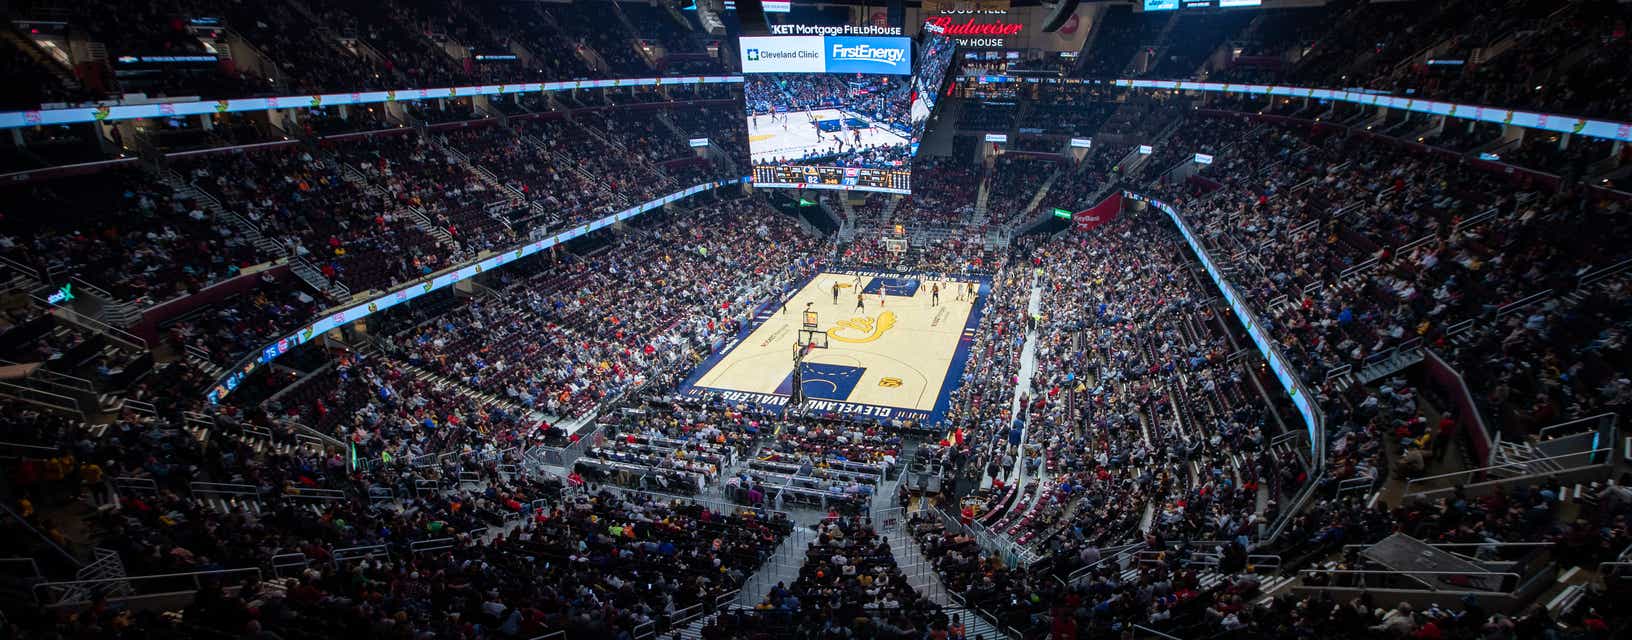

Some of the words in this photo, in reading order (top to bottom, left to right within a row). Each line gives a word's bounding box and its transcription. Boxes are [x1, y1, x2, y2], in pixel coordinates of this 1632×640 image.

[772, 25, 795, 35] KET
[796, 24, 843, 36] Mortgage
[844, 25, 901, 35] FIELDHOUSE
[926, 16, 1023, 35] Budweiser
[970, 38, 1004, 47] HOUSE
[760, 51, 797, 59] Cleveland
[798, 50, 819, 59] Clinic
[832, 44, 906, 62] FirstEnergy
[807, 175, 818, 184] 82
[846, 270, 899, 278] CLEVELAND
[722, 391, 790, 406] AVALIERS
[808, 399, 892, 417] CLEVELAND
